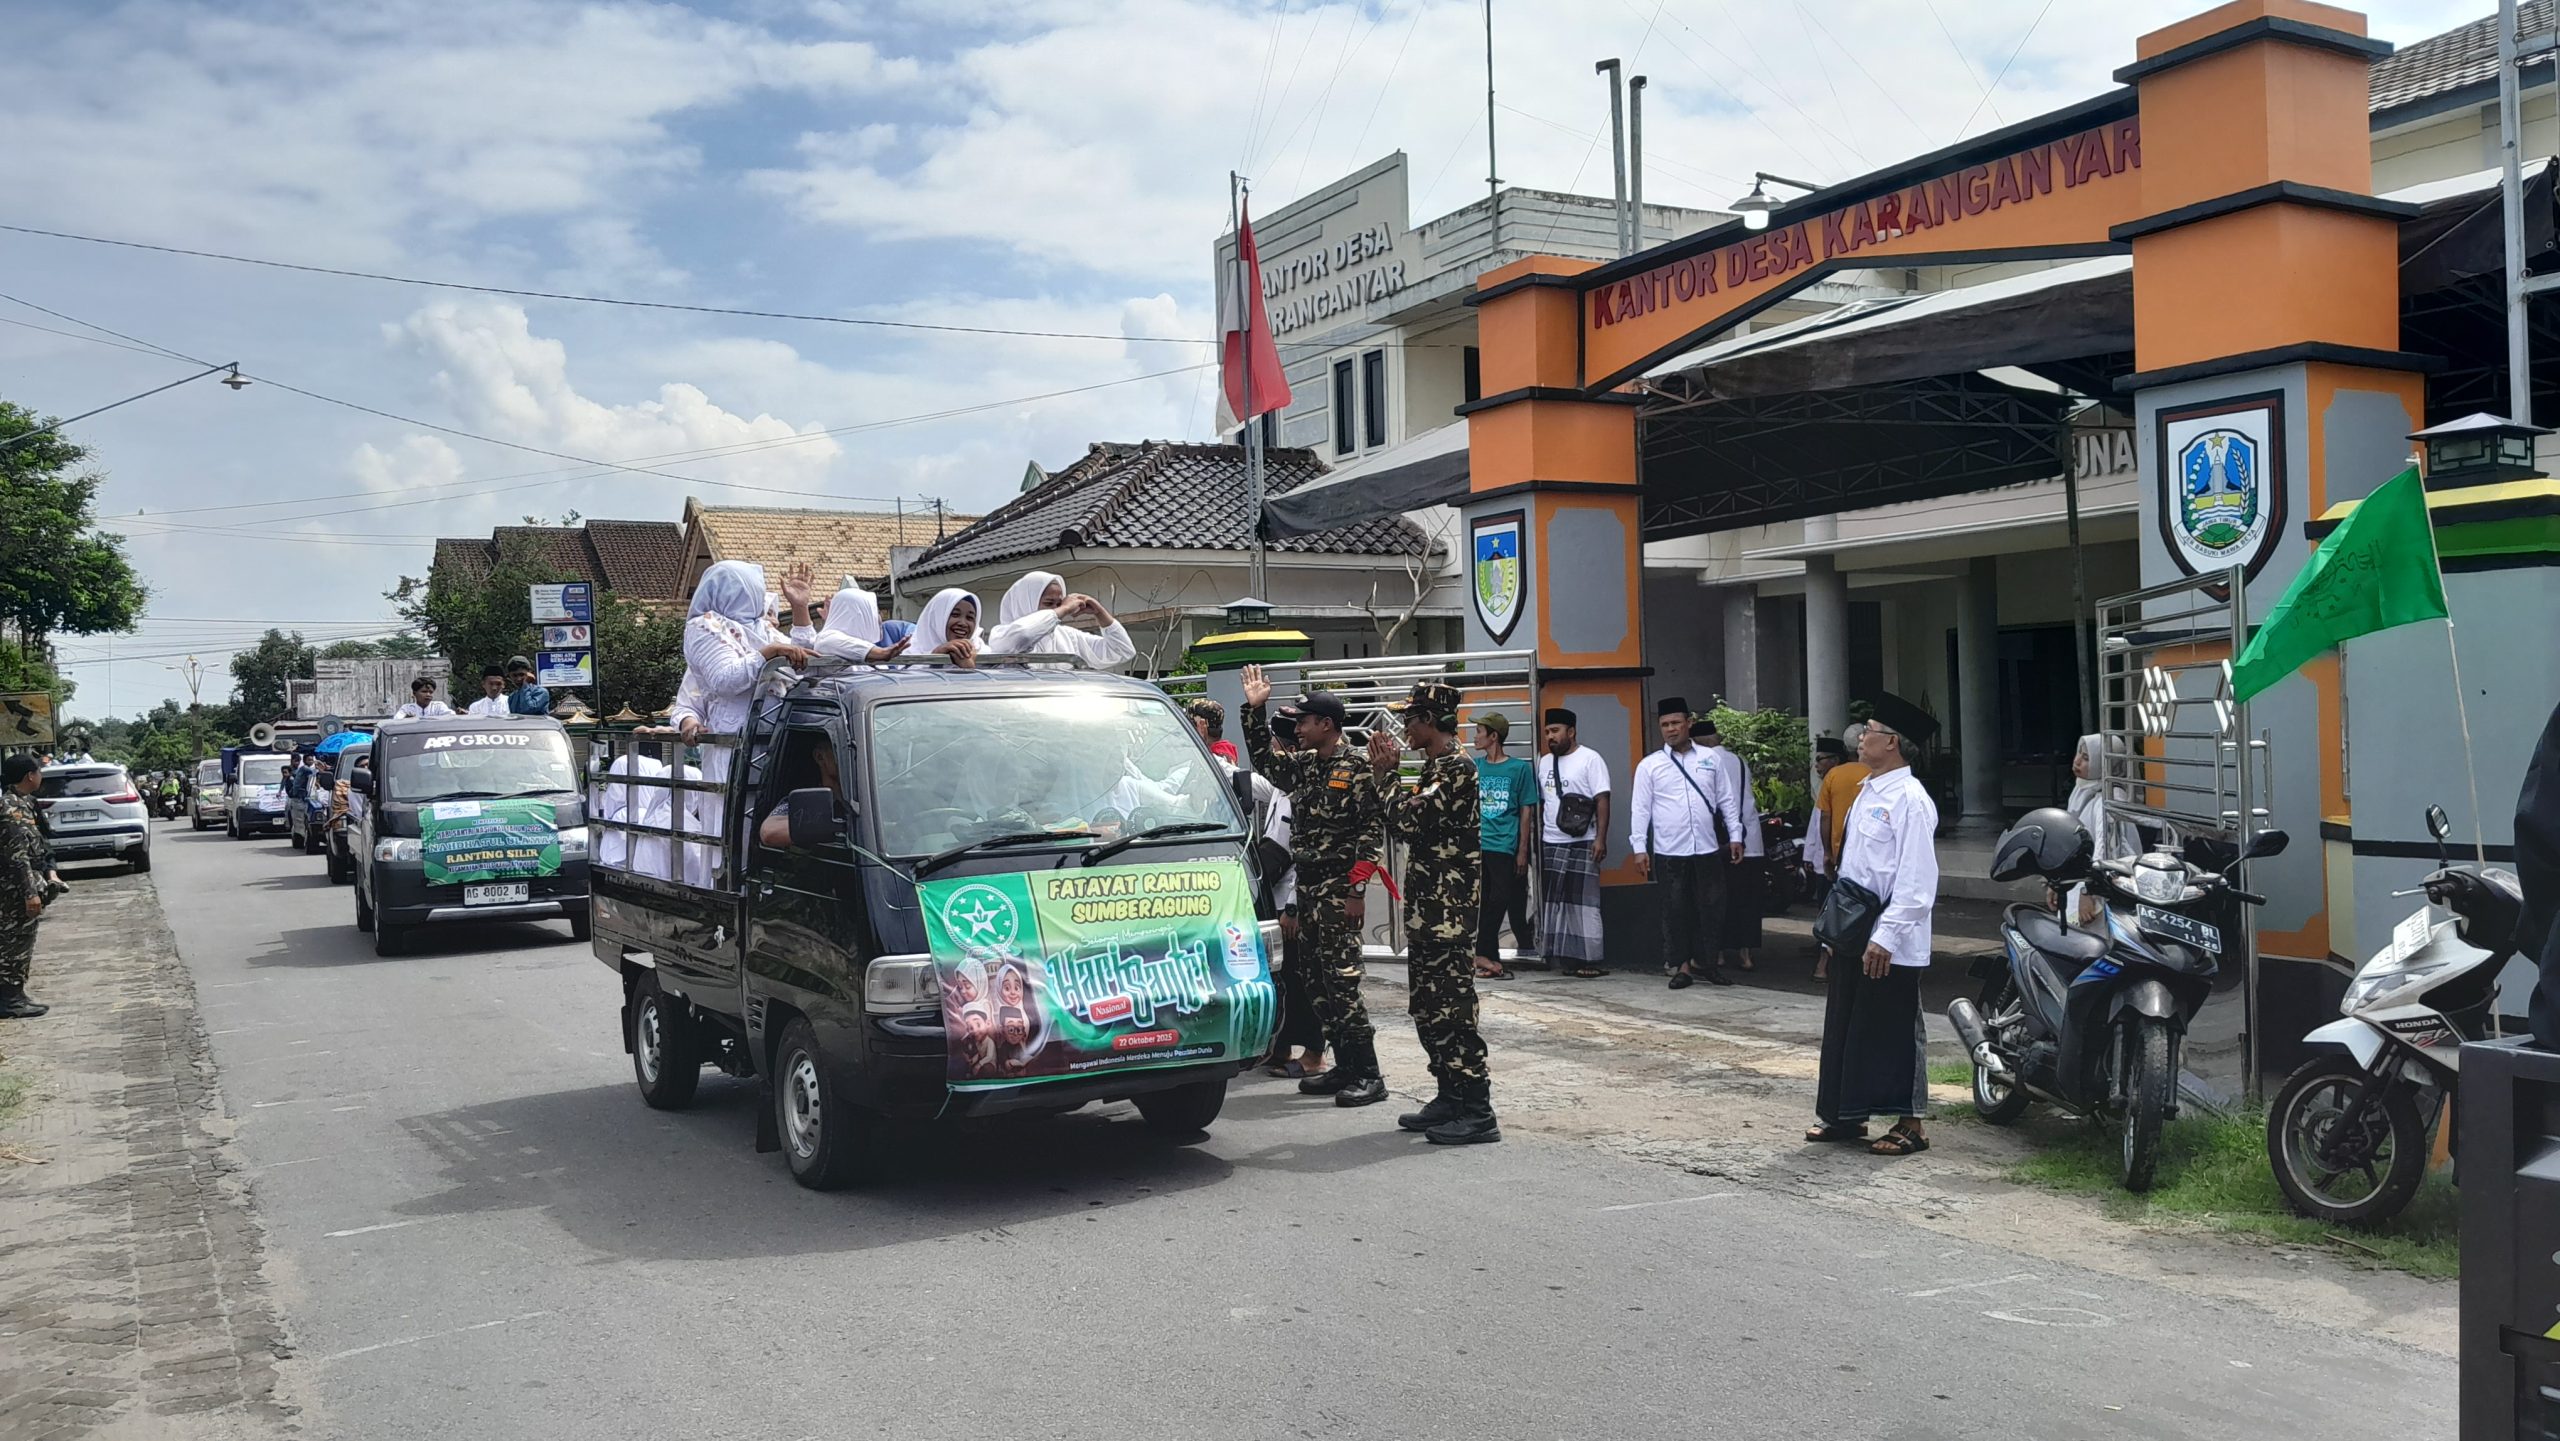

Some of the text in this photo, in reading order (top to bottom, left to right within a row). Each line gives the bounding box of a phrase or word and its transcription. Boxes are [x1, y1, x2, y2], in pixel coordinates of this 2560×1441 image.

[1594, 114, 2141, 329] KANTOR DESA KARANGANYAR
[1263, 221, 1393, 298] ANTOR DESA
[2201, 517, 2238, 529] JAWA TIMUR
[2183, 528, 2256, 557] JER BASUKI MAWA BEYA
[459, 734, 530, 746] GROUP
[446, 849, 539, 863] RANTING SILIR
[466, 887, 479, 898] AG
[483, 886, 509, 897] 8002
[1049, 871, 1220, 900] FATAYAT RANTING
[1071, 895, 1211, 924] SUMBERAGUNG
[1046, 931, 1216, 1028] Hari Santri
[1095, 1001, 1127, 1017] Nasional
[2395, 1019, 2440, 1029] HONDA
[1119, 1032, 1173, 1047] 22 Oktober 2025
[1099, 1056, 1125, 1066] Indonesia
[1126, 1053, 1151, 1062] Merdeka
[1152, 1050, 1173, 1059] Menuju
